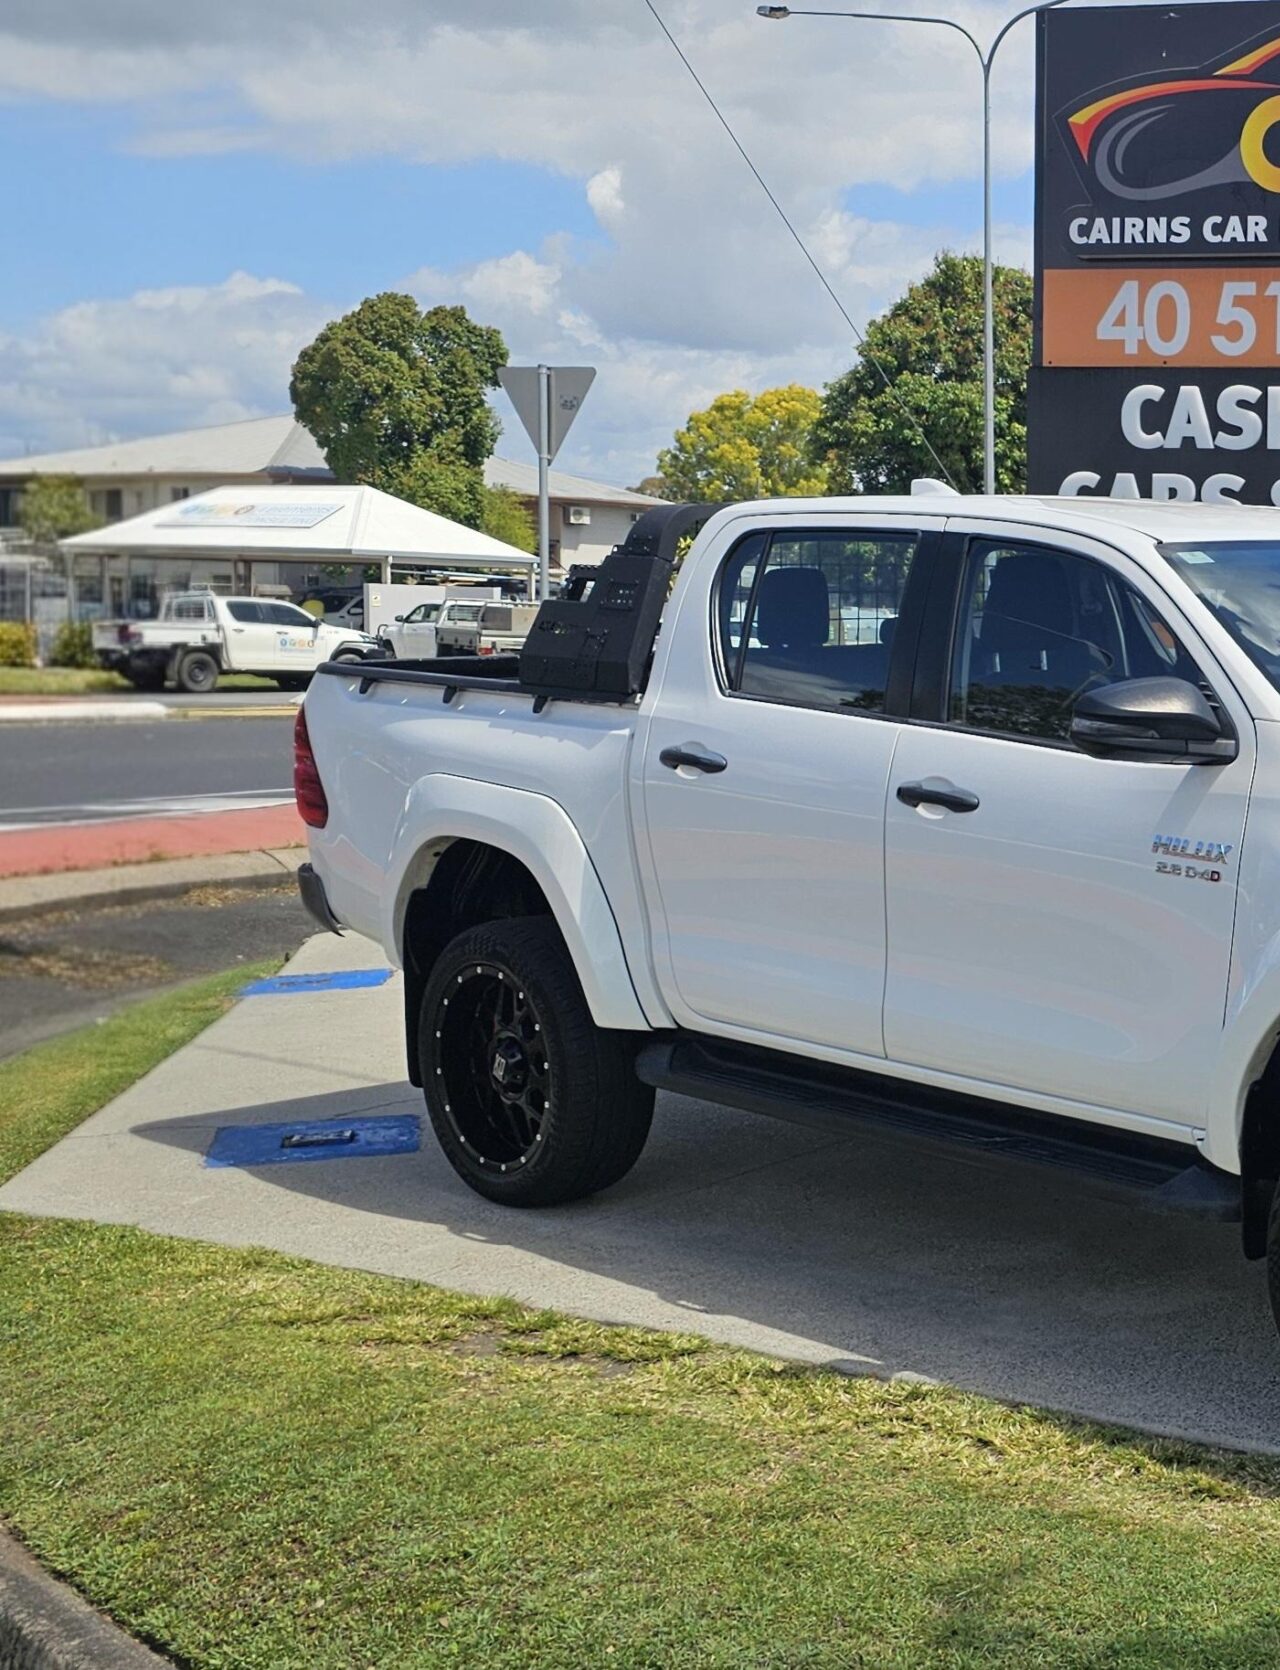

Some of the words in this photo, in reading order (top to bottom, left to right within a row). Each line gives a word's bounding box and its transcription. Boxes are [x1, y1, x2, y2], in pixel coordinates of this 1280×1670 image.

[1069, 216, 1191, 245] CAIRNS
[1202, 215, 1267, 243] CAR
[1096, 280, 1191, 356] 40
